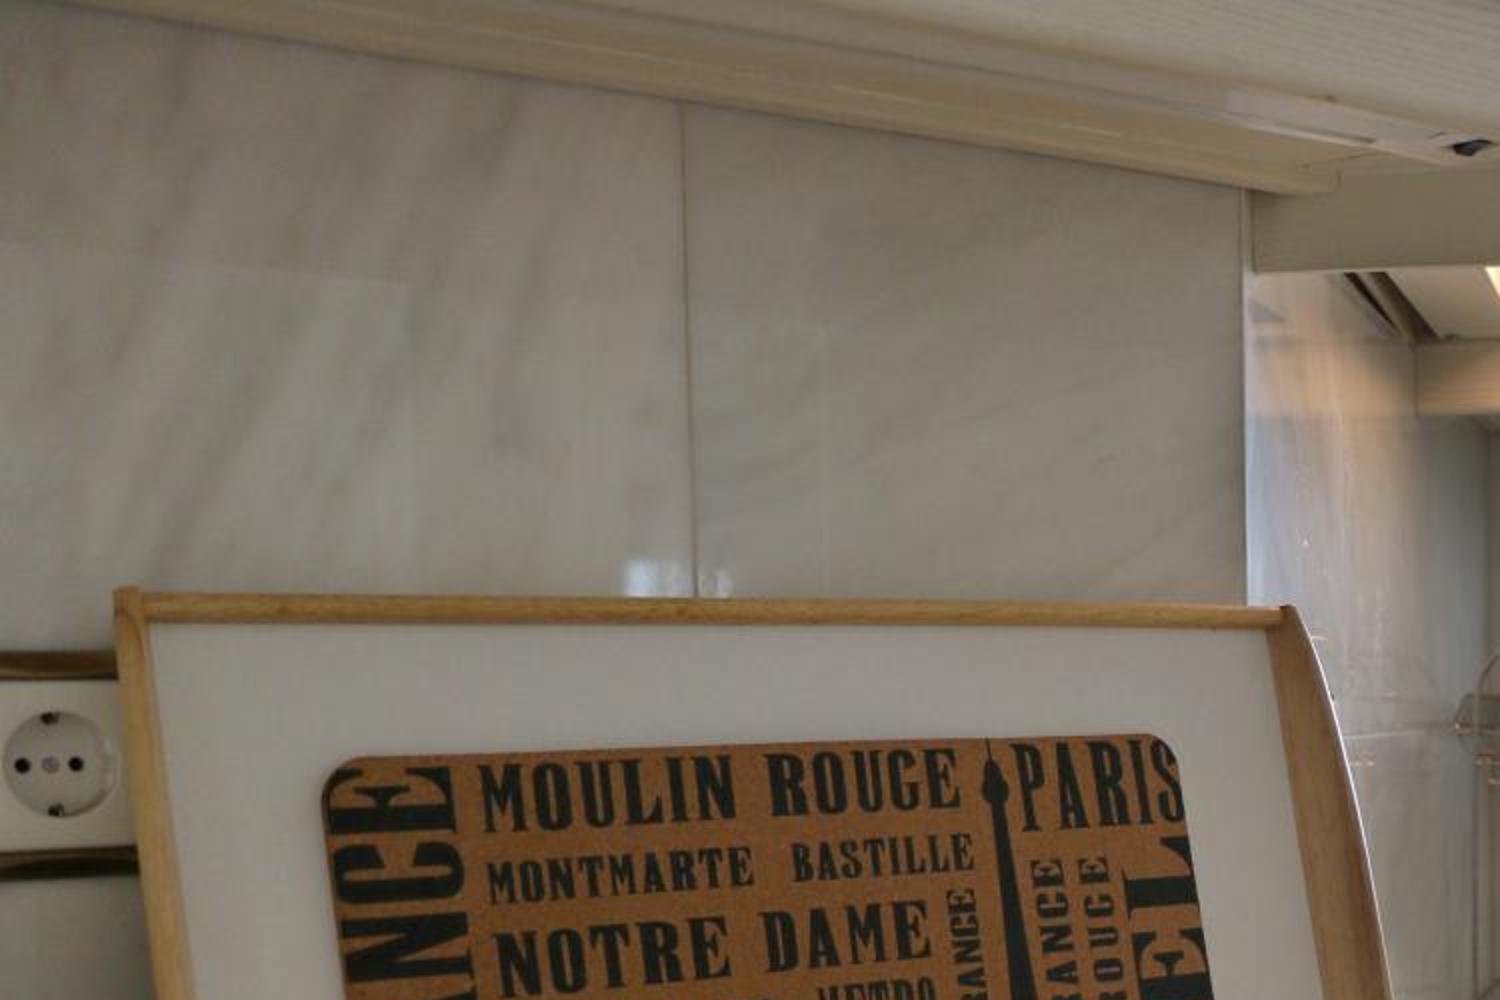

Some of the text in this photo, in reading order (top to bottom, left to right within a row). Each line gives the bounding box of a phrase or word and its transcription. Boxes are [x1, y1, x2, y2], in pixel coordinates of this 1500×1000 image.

[477, 748, 961, 833] MOULIN ROUGE
[1010, 739, 1185, 832] PARIS
[487, 833, 975, 904] MONTMARTE BASTILLE
[494, 900, 933, 998] NOTRE DAME
